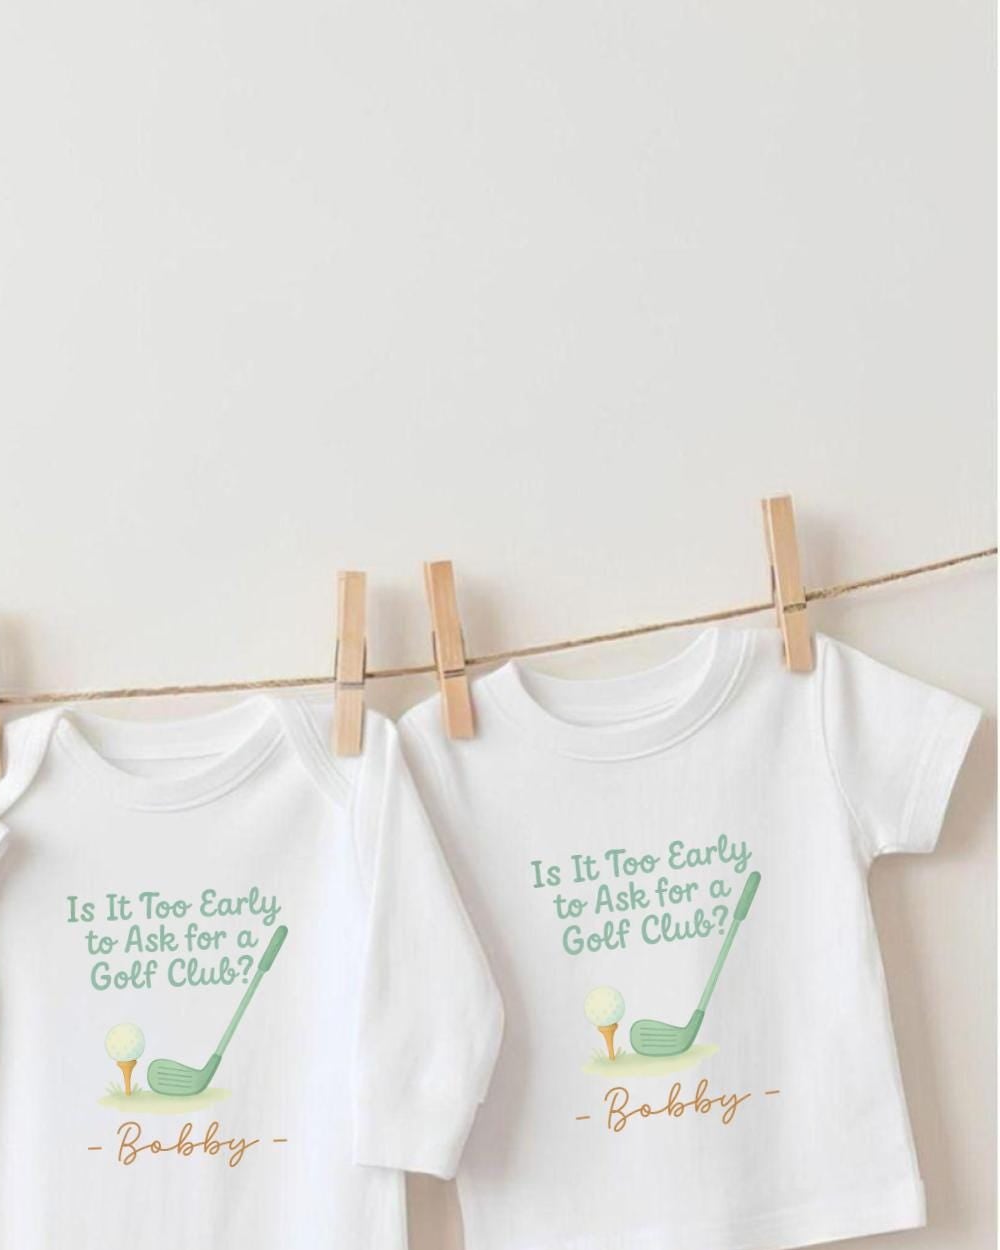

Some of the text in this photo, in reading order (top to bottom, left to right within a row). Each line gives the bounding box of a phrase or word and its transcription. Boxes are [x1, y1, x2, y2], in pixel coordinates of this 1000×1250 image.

[531, 834, 752, 888] Is It Too Early
[66, 886, 281, 926] Is It Too Early
[553, 877, 732, 919] to Ask for a
[85, 923, 258, 955] to Ask for a
[562, 905, 729, 955] Golf Club?
[90, 954, 254, 991] Golf Club?
[604, 1079, 751, 1132] Bobby
[117, 1121, 260, 1168] Bobby
